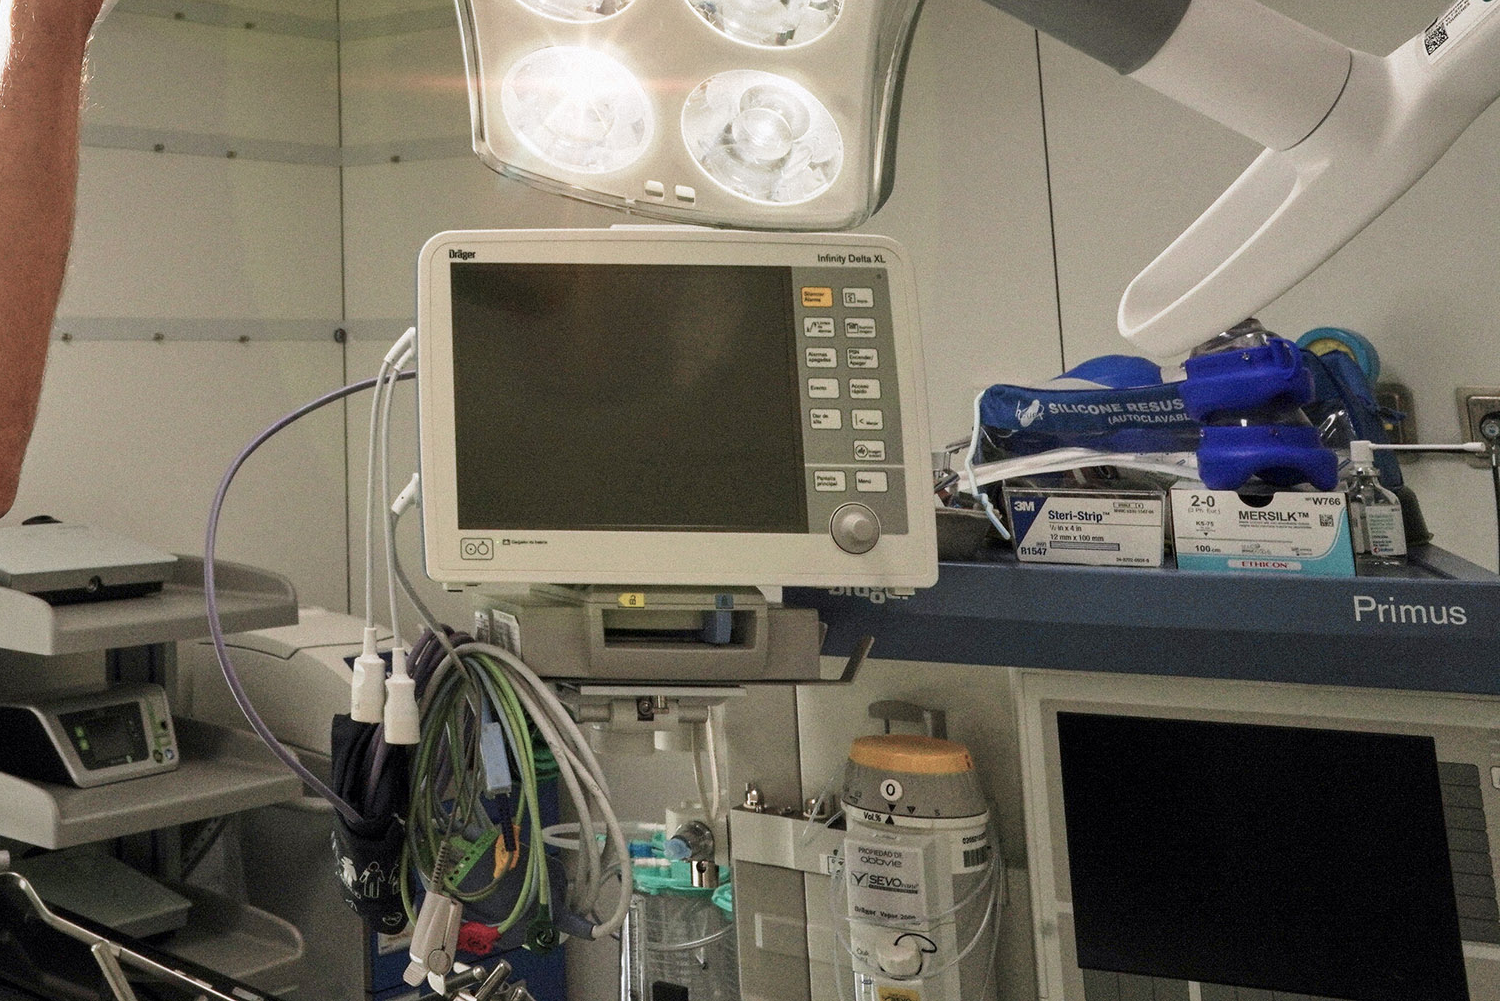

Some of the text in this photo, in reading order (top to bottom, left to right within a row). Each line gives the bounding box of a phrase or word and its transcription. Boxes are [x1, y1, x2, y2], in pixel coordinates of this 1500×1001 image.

[448, 249, 476, 260] Dräger
[817, 253, 887, 265] Infinity Delta XL
[1049, 402, 1124, 415] SILICONE
[1127, 399, 1185, 412] RESUS
[1014, 501, 1035, 512] 3M
[1191, 495, 1216, 508] 2-0
[1312, 497, 1341, 506] W766
[1020, 547, 1047, 556] R1547
[1195, 545, 1211, 553] 100
[1353, 595, 1468, 625] Primus
[860, 856, 902, 868] abbvie
